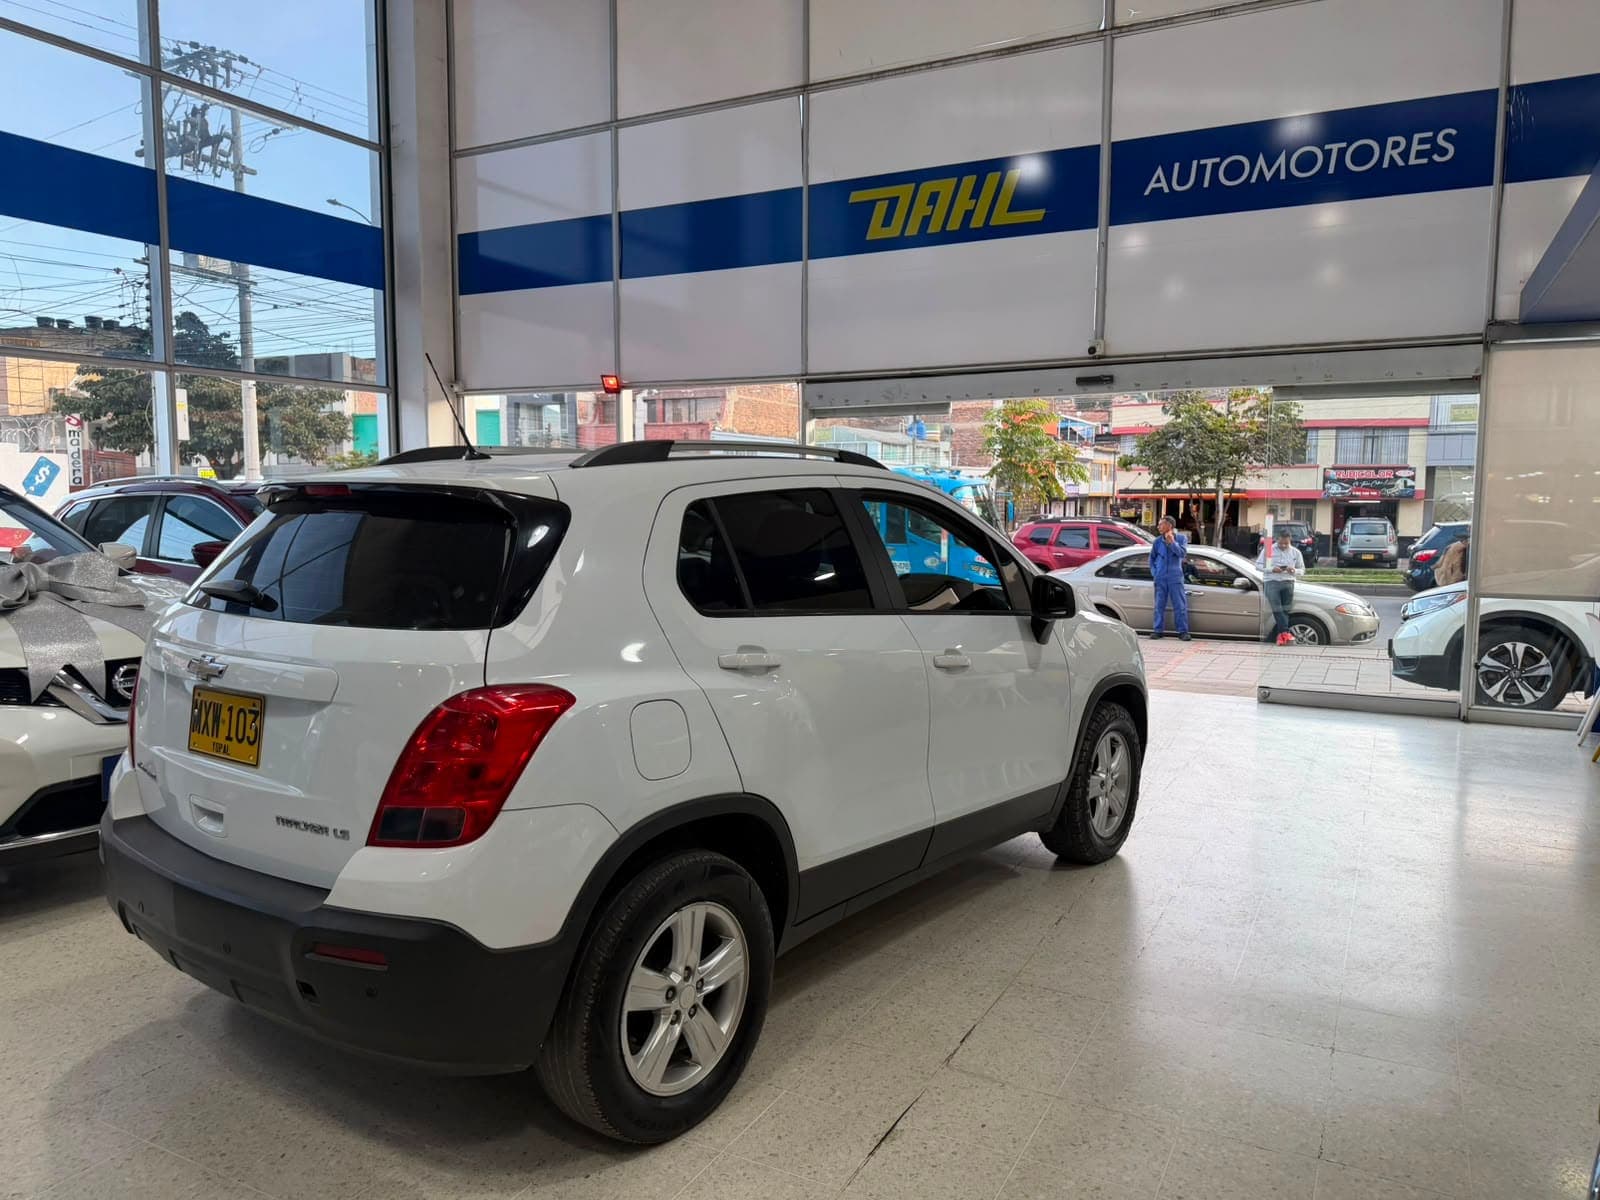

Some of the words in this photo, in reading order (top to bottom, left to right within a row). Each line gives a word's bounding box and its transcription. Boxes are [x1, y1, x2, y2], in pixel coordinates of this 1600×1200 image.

[1144, 128, 1457, 195] AUTOMOTORES
[848, 169, 1046, 240] DAHL
[69, 430, 82, 485] madera
[1335, 469, 1394, 479] RUBICOLOR
